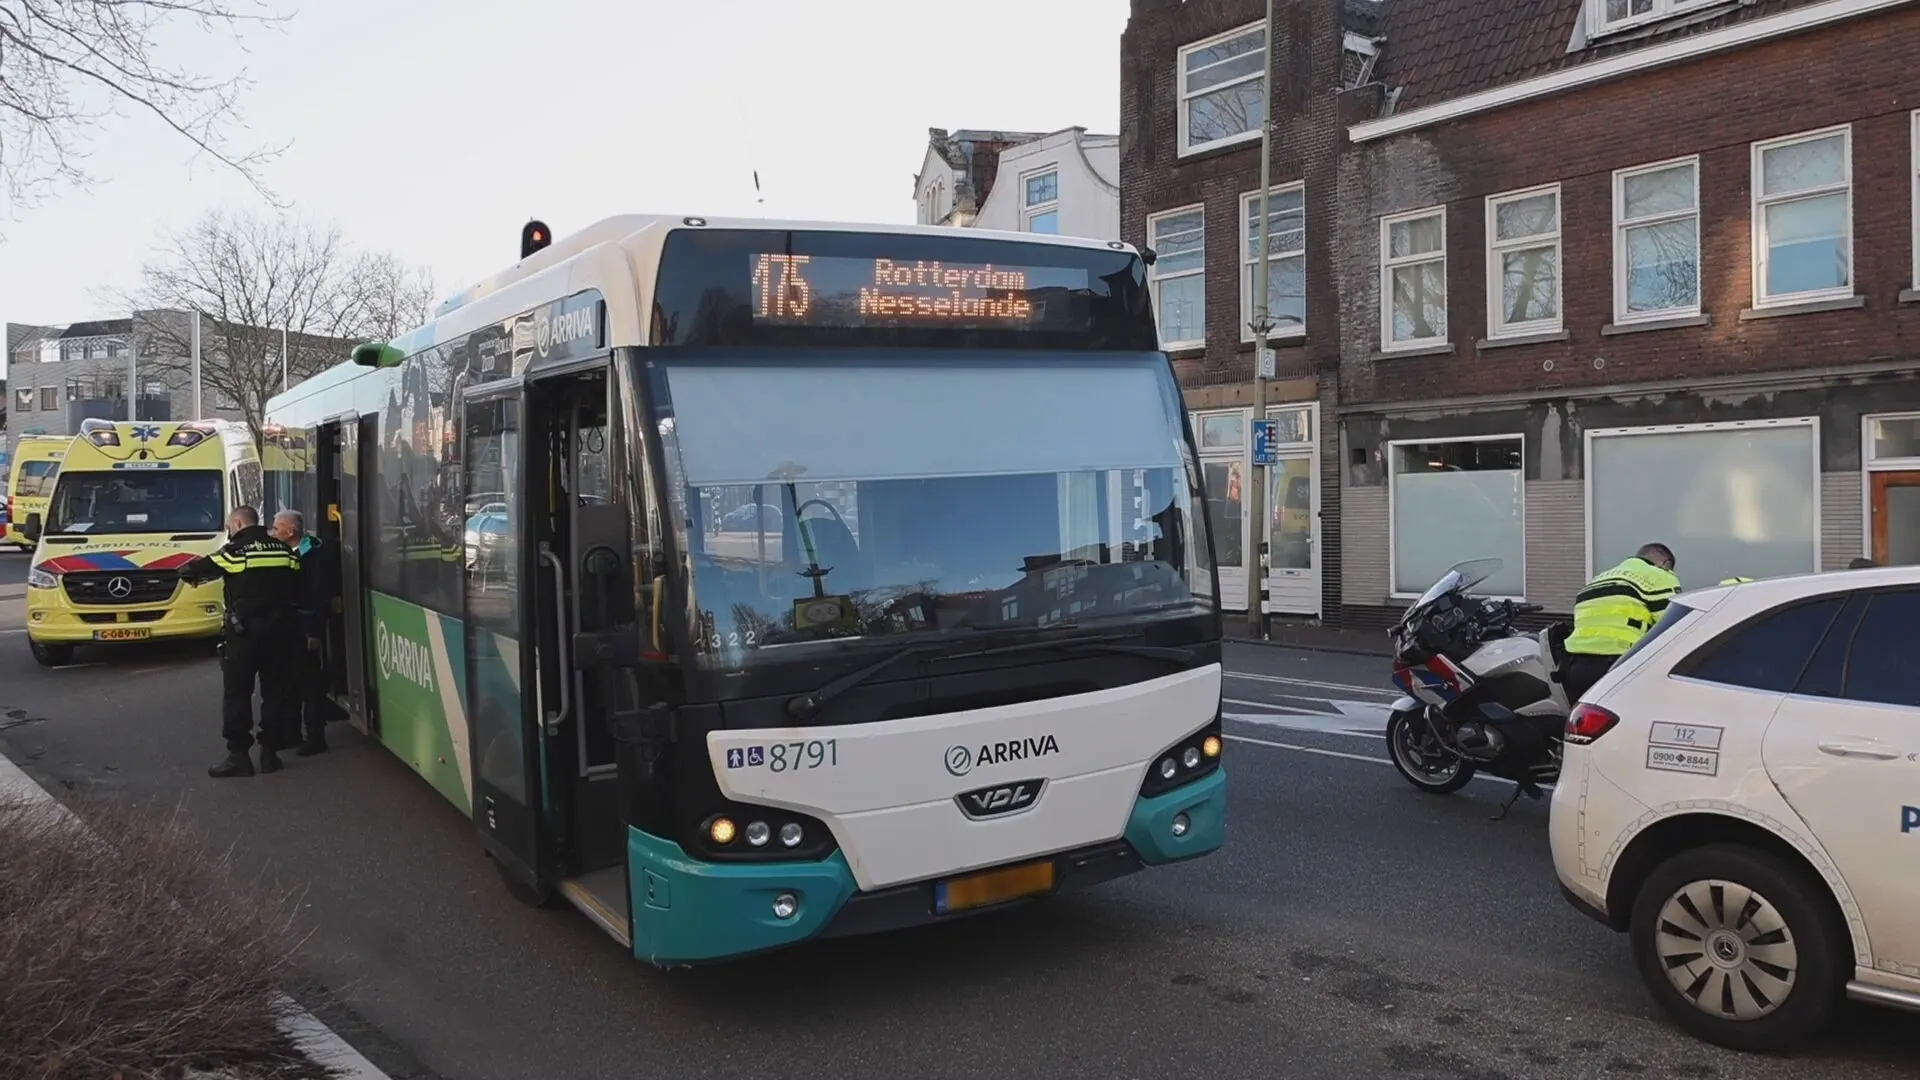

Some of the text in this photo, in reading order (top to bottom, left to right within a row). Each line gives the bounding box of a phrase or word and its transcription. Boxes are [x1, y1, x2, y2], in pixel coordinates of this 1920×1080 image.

[752, 254, 810, 317] 175
[876, 258, 1025, 289] Rotterdam
[860, 288, 1031, 318] Nesselande
[550, 306, 594, 346] ARRIVA
[72, 542, 182, 551] AMBULANCE
[391, 632, 433, 693] ARRIVA
[1675, 728, 1695, 740] 112
[769, 739, 837, 773] 8791
[976, 734, 1060, 767] ARRIVA
[1653, 752, 1674, 762] 0900
[970, 785, 1031, 809] VDL
